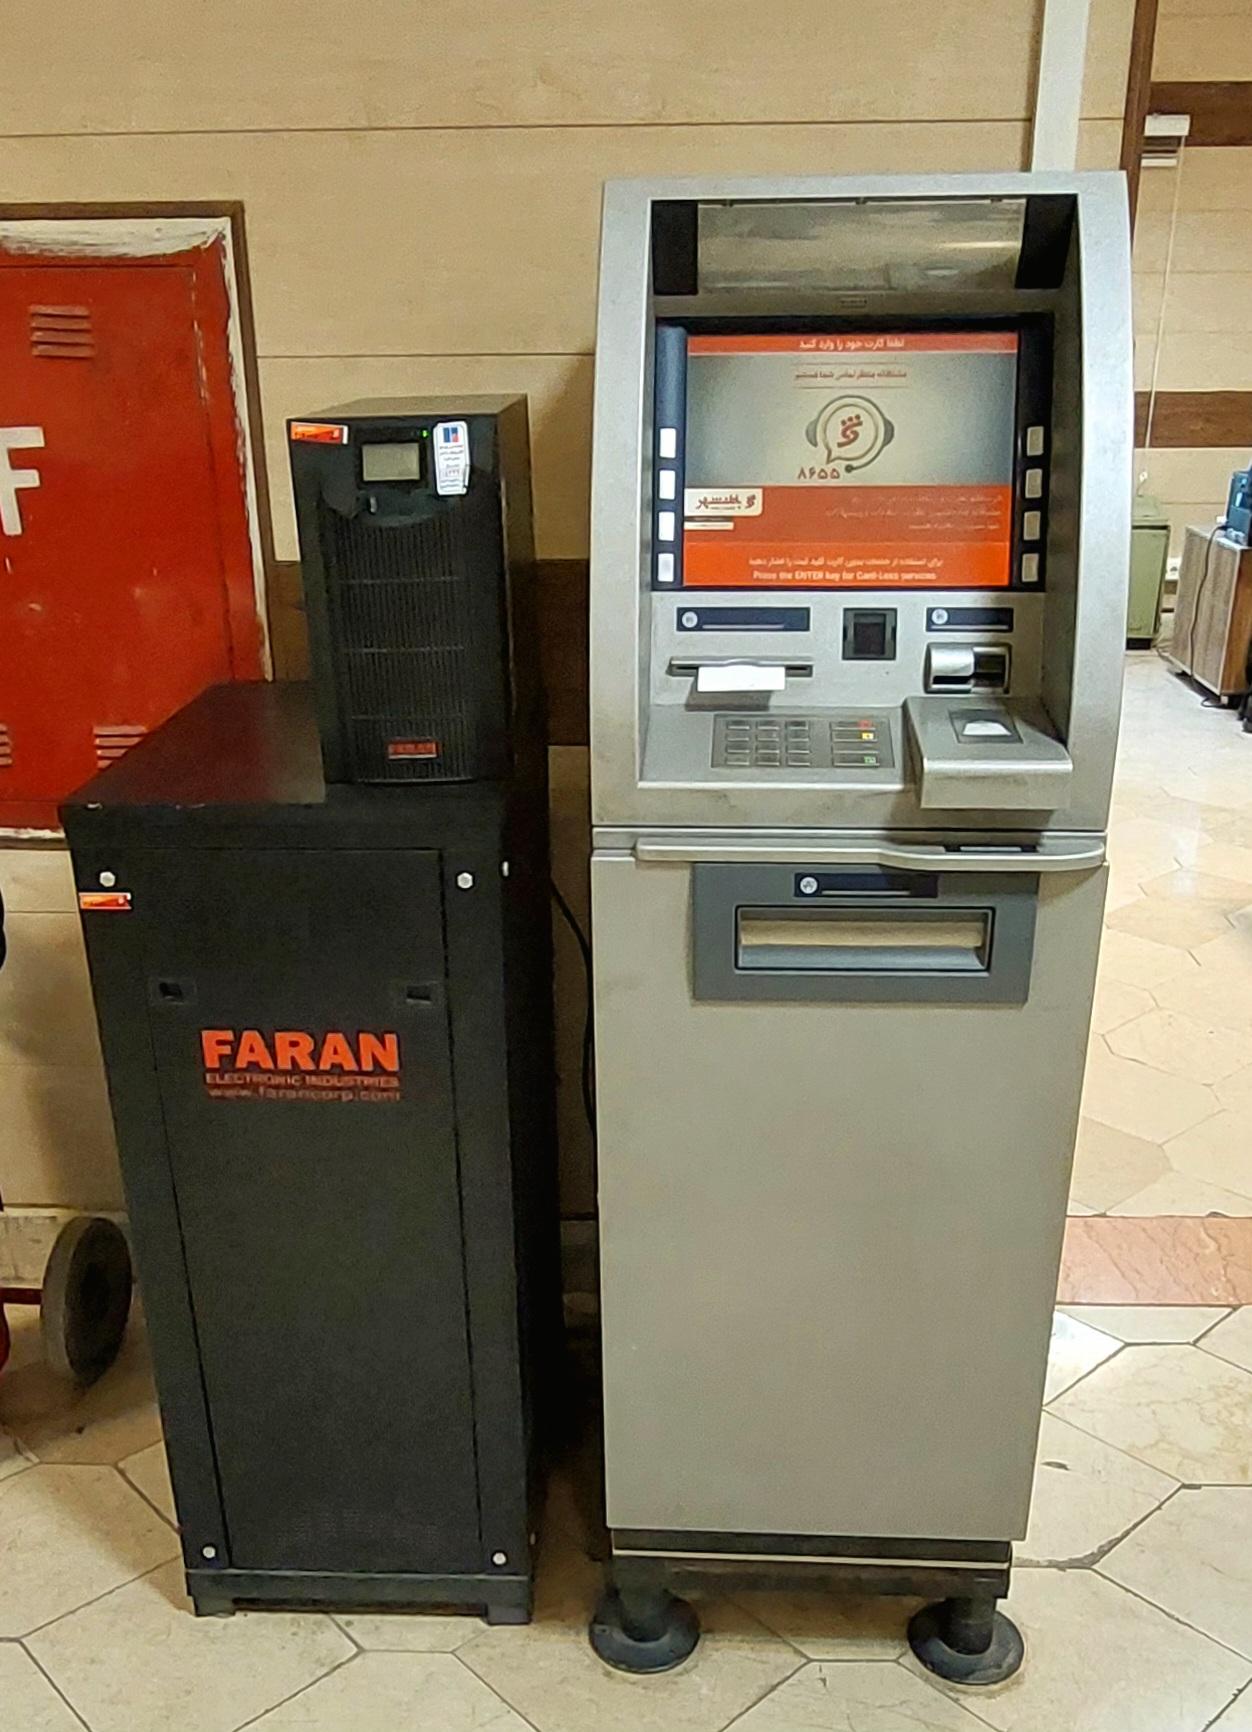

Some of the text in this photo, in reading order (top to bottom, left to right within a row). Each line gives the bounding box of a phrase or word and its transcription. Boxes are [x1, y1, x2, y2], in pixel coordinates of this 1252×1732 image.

[202, 1030, 399, 1072] FARAN
[205, 1072, 400, 1088] ELECTRONIC INDUSTRIES
